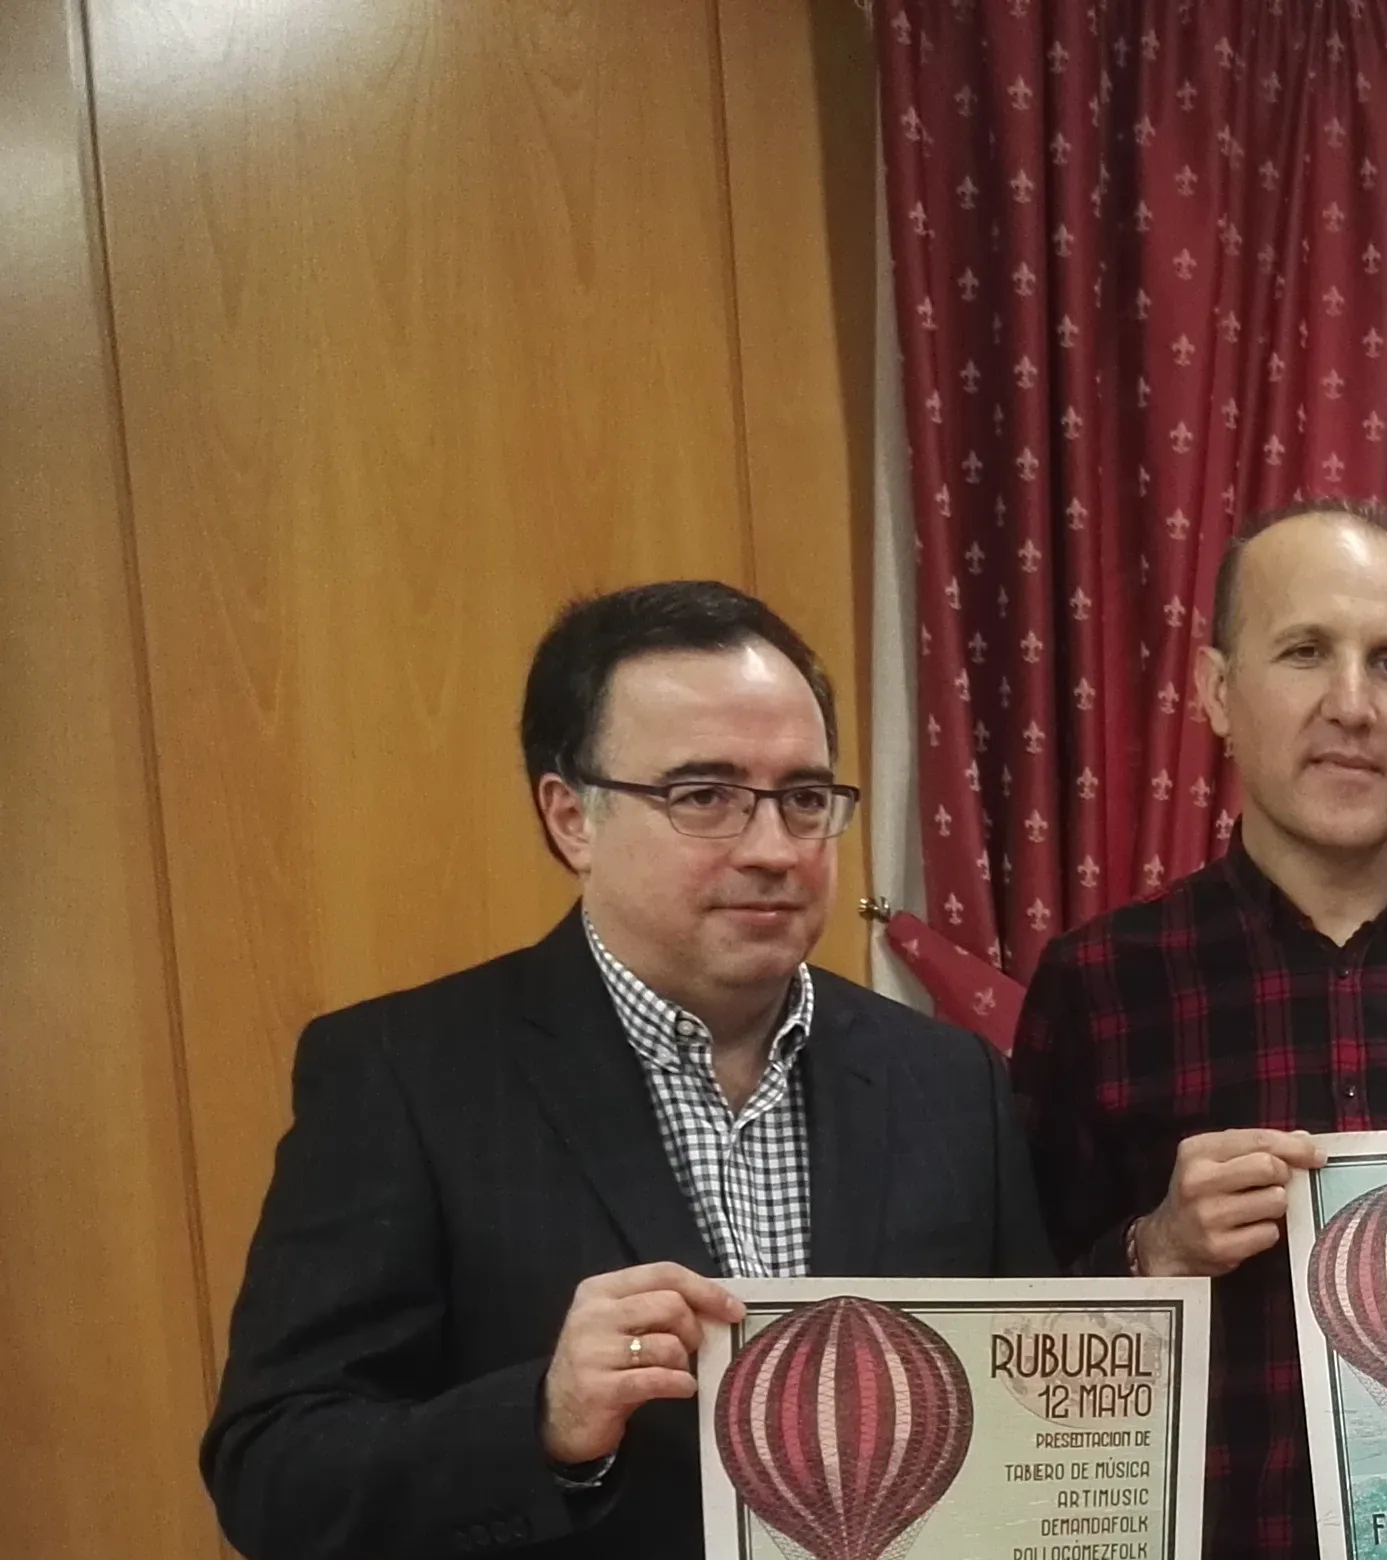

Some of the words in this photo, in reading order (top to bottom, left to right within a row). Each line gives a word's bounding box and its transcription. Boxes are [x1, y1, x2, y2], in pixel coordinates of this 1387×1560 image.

[990, 1333, 1153, 1377] RUBURAL
[1037, 1385, 1069, 1417] 12
[1079, 1384, 1152, 1417] MAYO
[1135, 1431, 1150, 1446] DE
[1071, 1463, 1089, 1479] DE
[1058, 1488, 1149, 1507] ARTIMUSIC
[1041, 1516, 1147, 1536] DEMANDAFOLK
